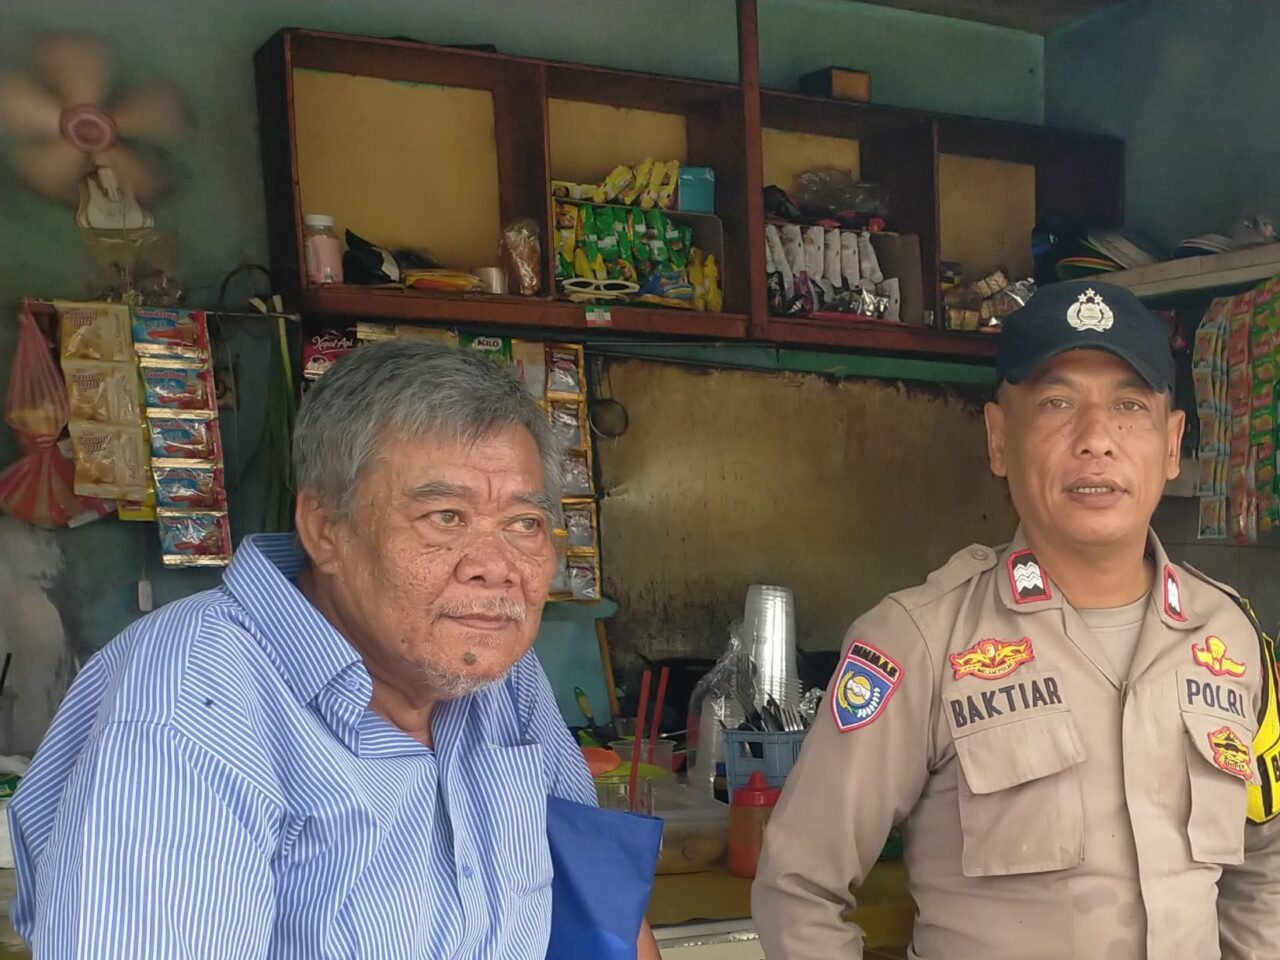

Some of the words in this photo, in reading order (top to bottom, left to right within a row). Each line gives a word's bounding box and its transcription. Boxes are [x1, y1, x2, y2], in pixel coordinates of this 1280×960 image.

[476, 338, 501, 348] MILO
[950, 676, 1064, 729] BAKTIAR
[1185, 678, 1248, 719] POLRI
